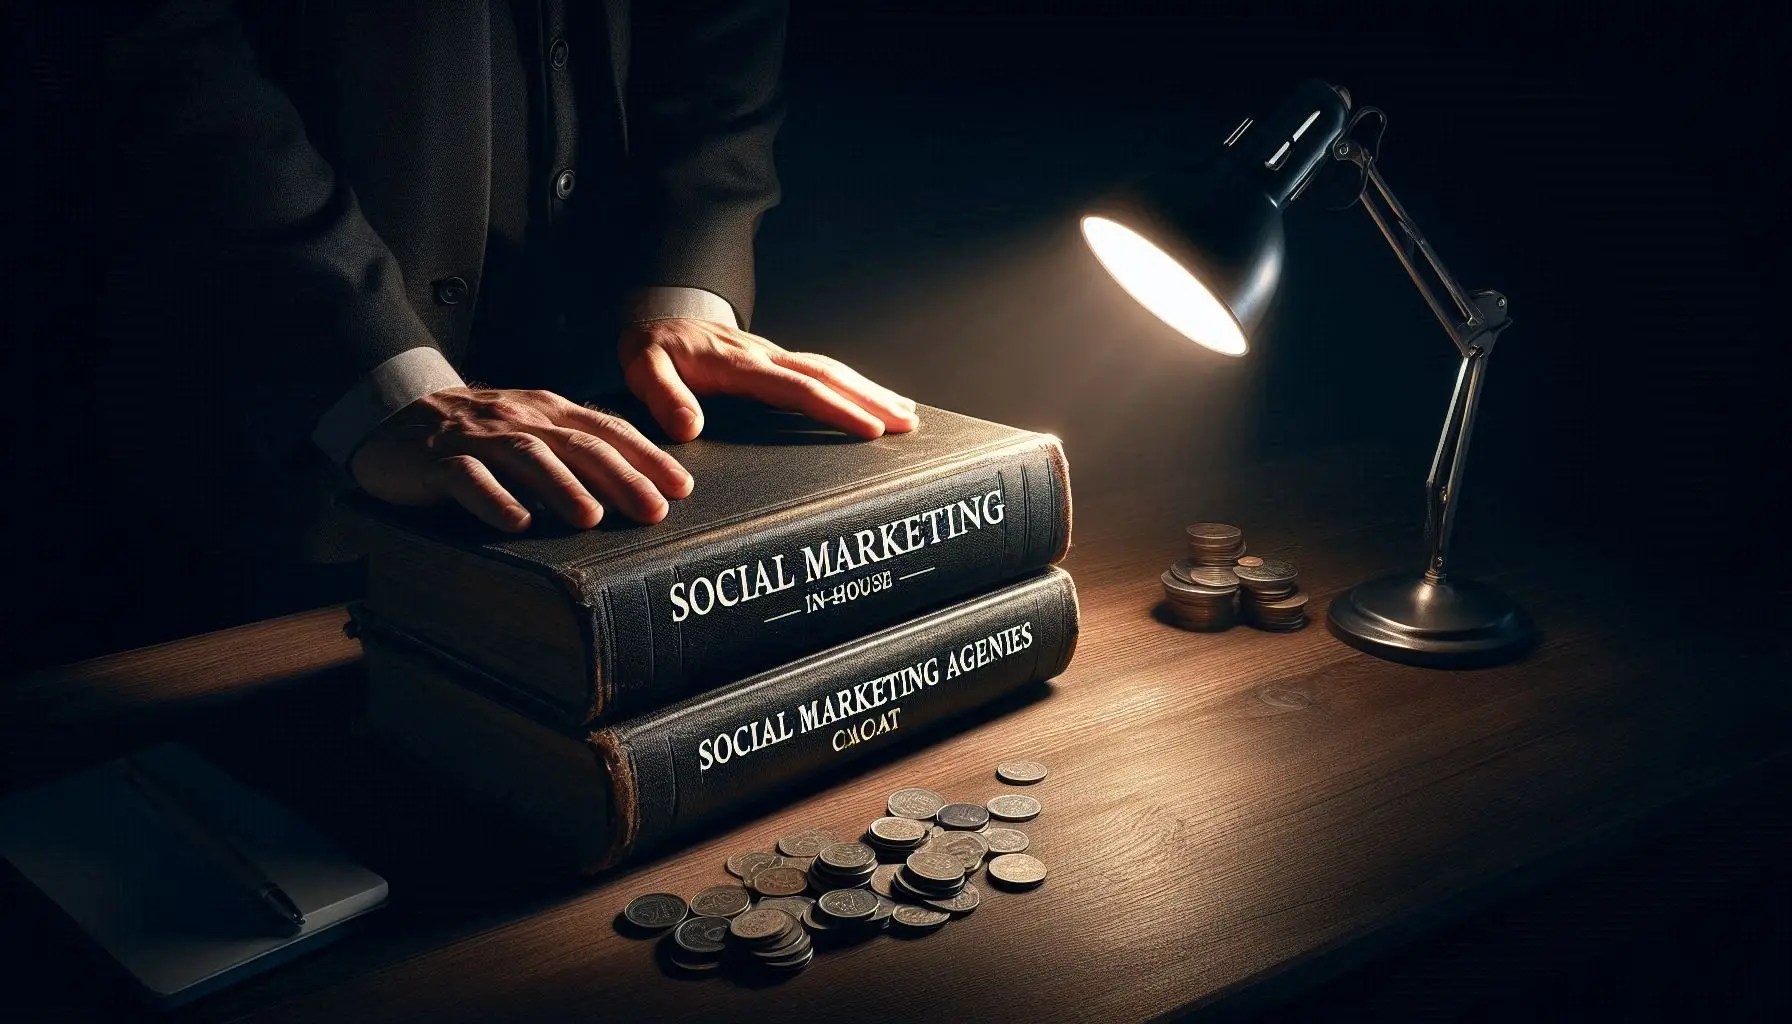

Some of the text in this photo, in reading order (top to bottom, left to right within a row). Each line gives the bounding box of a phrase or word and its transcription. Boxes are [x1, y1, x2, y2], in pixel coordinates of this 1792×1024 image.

[669, 489, 1005, 623] SOCIAL MARKETING
[805, 570, 893, 614] IN-HOUSE
[699, 712, 794, 771] SOCIAL
[799, 657, 939, 733] MARKETING
